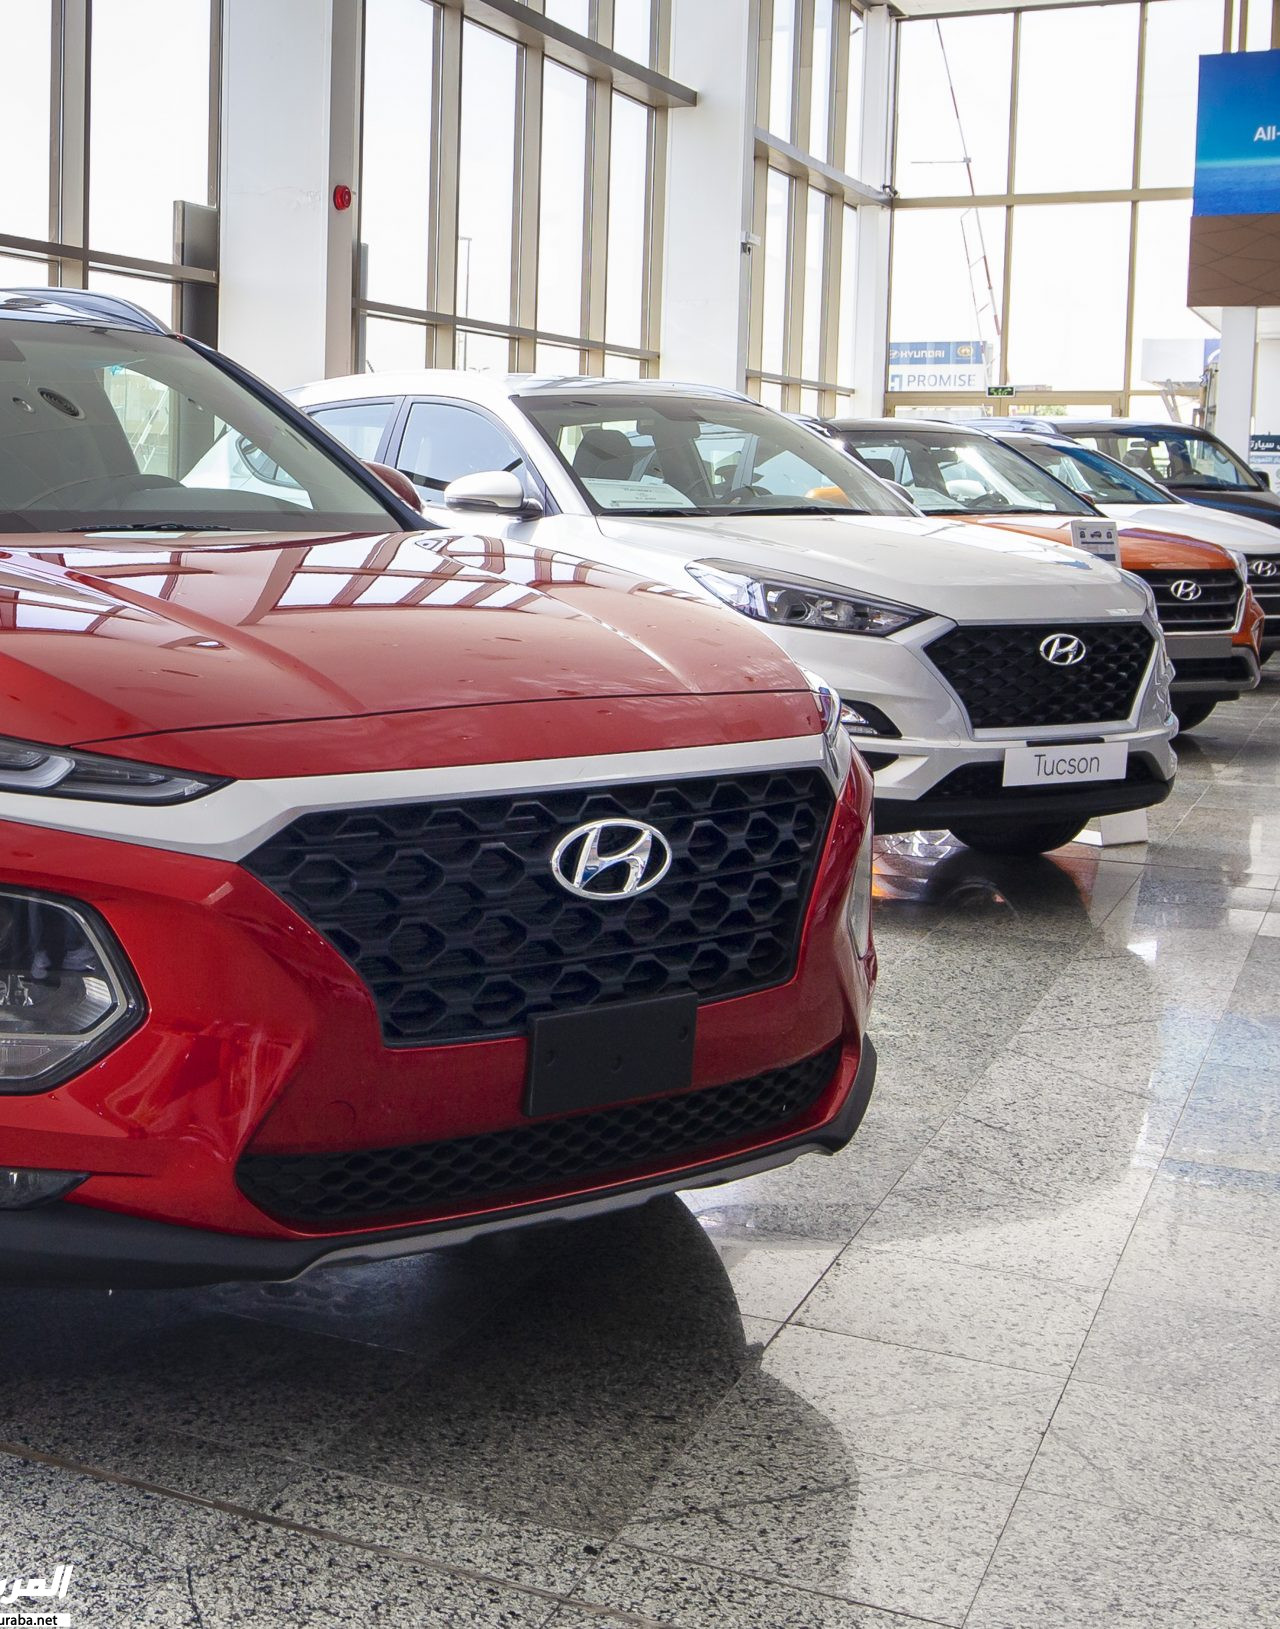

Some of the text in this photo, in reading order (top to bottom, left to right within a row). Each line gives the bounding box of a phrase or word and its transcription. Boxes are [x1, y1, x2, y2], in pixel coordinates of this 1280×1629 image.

[900, 349, 945, 359] HYUNDAI
[907, 373, 977, 387] PROMISE
[1250, 440, 1275, 450] سيارت
[1034, 754, 1100, 776] Tucson
